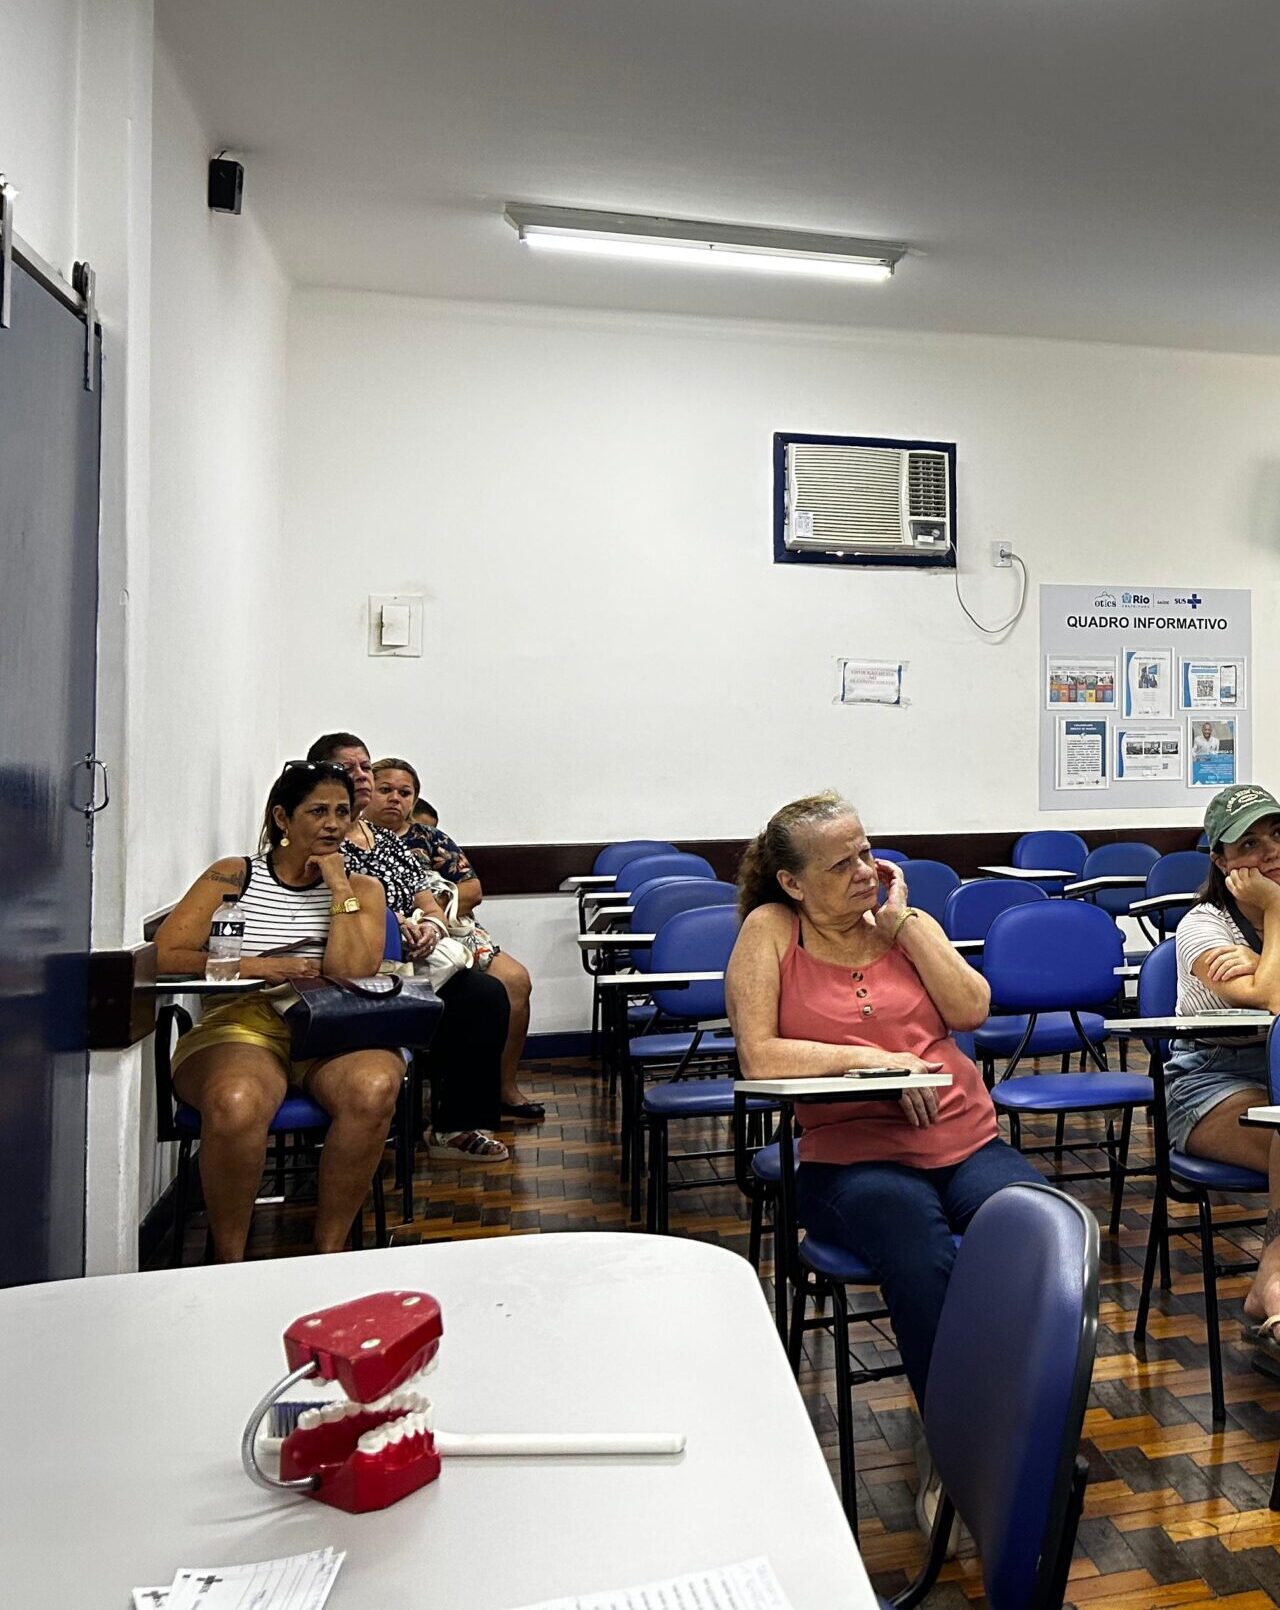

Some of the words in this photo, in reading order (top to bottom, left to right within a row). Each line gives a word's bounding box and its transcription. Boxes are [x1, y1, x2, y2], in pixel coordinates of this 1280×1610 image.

[1095, 599, 1117, 608] otics
[1133, 595, 1150, 604] Rio
[1067, 615, 1129, 629] QUADRO
[1133, 617, 1228, 630] INFORMATIVO
